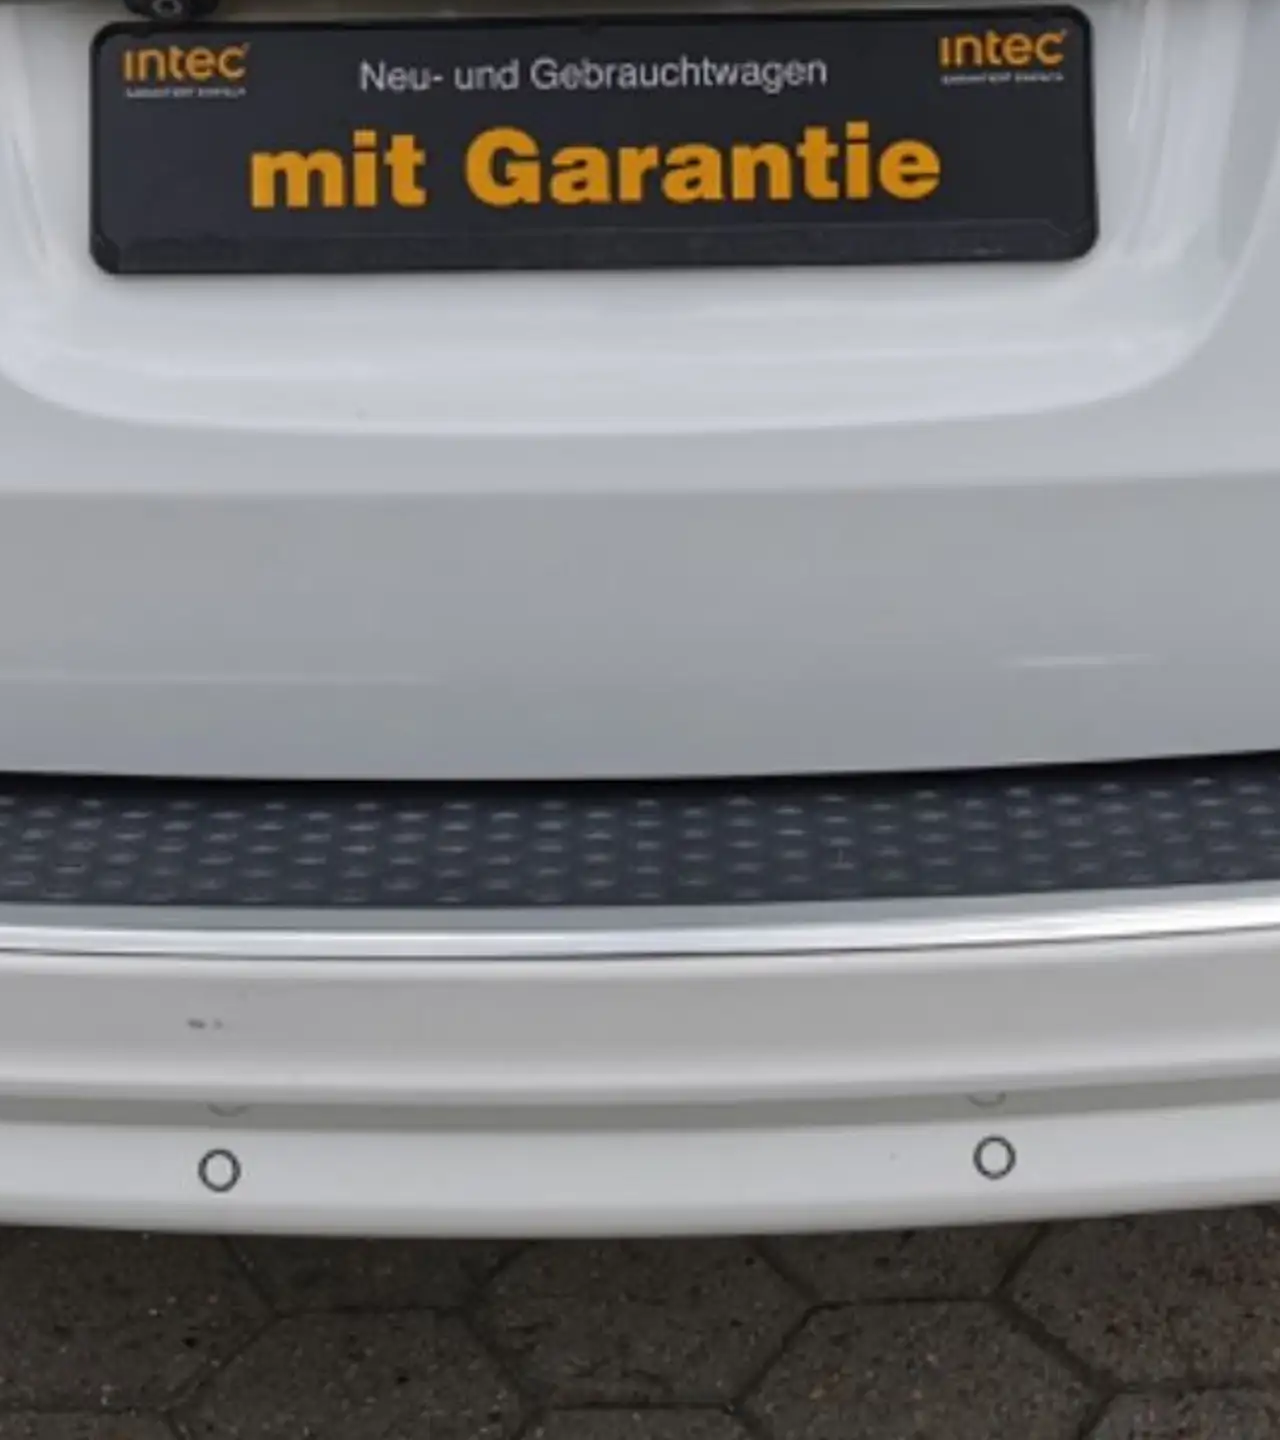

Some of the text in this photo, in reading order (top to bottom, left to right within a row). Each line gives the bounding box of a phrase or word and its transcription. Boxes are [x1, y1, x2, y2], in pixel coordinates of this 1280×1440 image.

[123, 45, 248, 81] intec
[939, 31, 1065, 67] intec
[359, 56, 828, 94] Neu- und Gebrauchtwagen
[249, 121, 942, 210] mit Garantie
